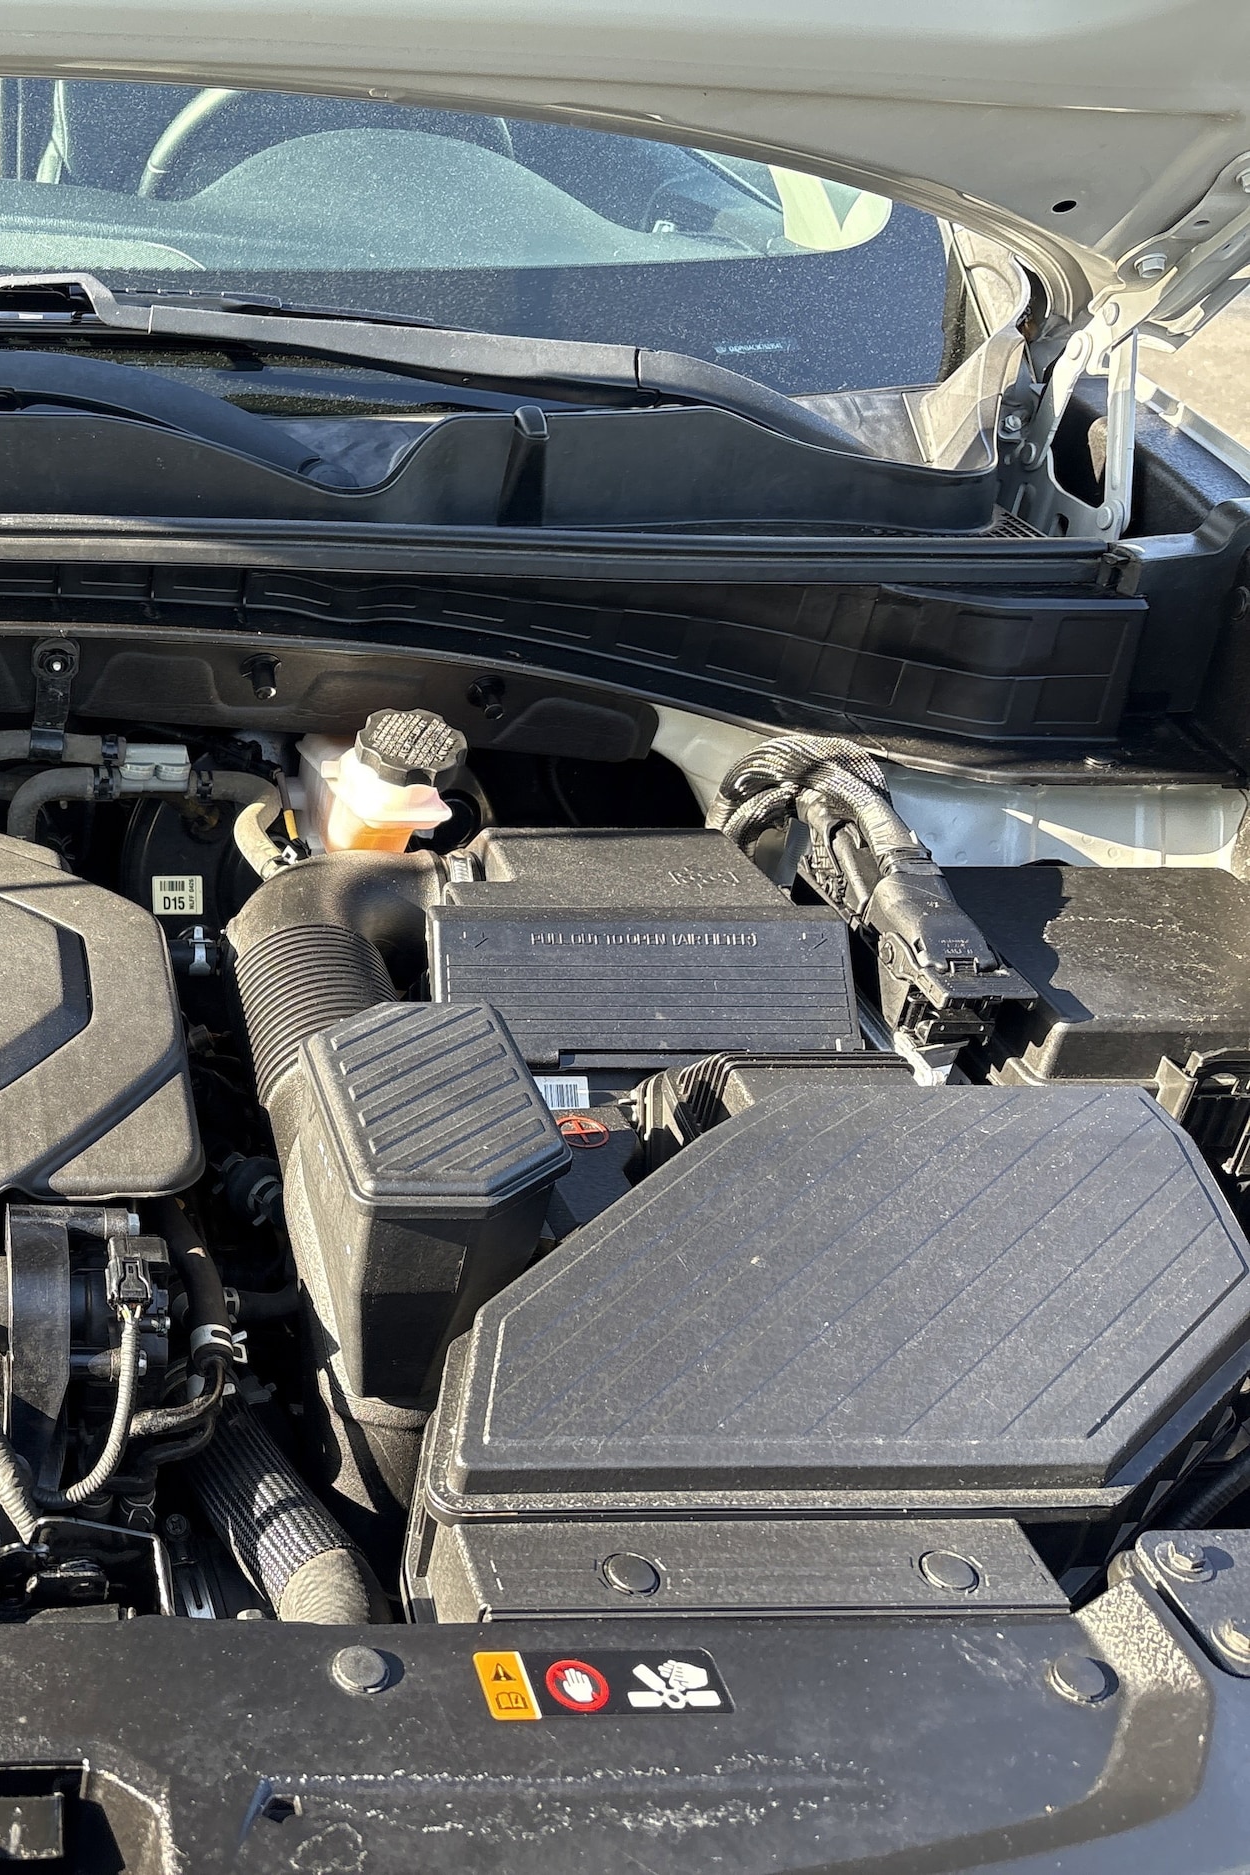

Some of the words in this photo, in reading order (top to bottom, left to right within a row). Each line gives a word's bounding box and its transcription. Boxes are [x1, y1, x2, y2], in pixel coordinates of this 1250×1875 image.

[163, 896, 185, 911] D15
[530, 932, 568, 945] PULL
[570, 932, 603, 945] OUT
[603, 932, 624, 945] TO
[626, 932, 666, 945] OPEN
[672, 932, 701, 946] (AIR
[704, 932, 758, 947] FILTER)
